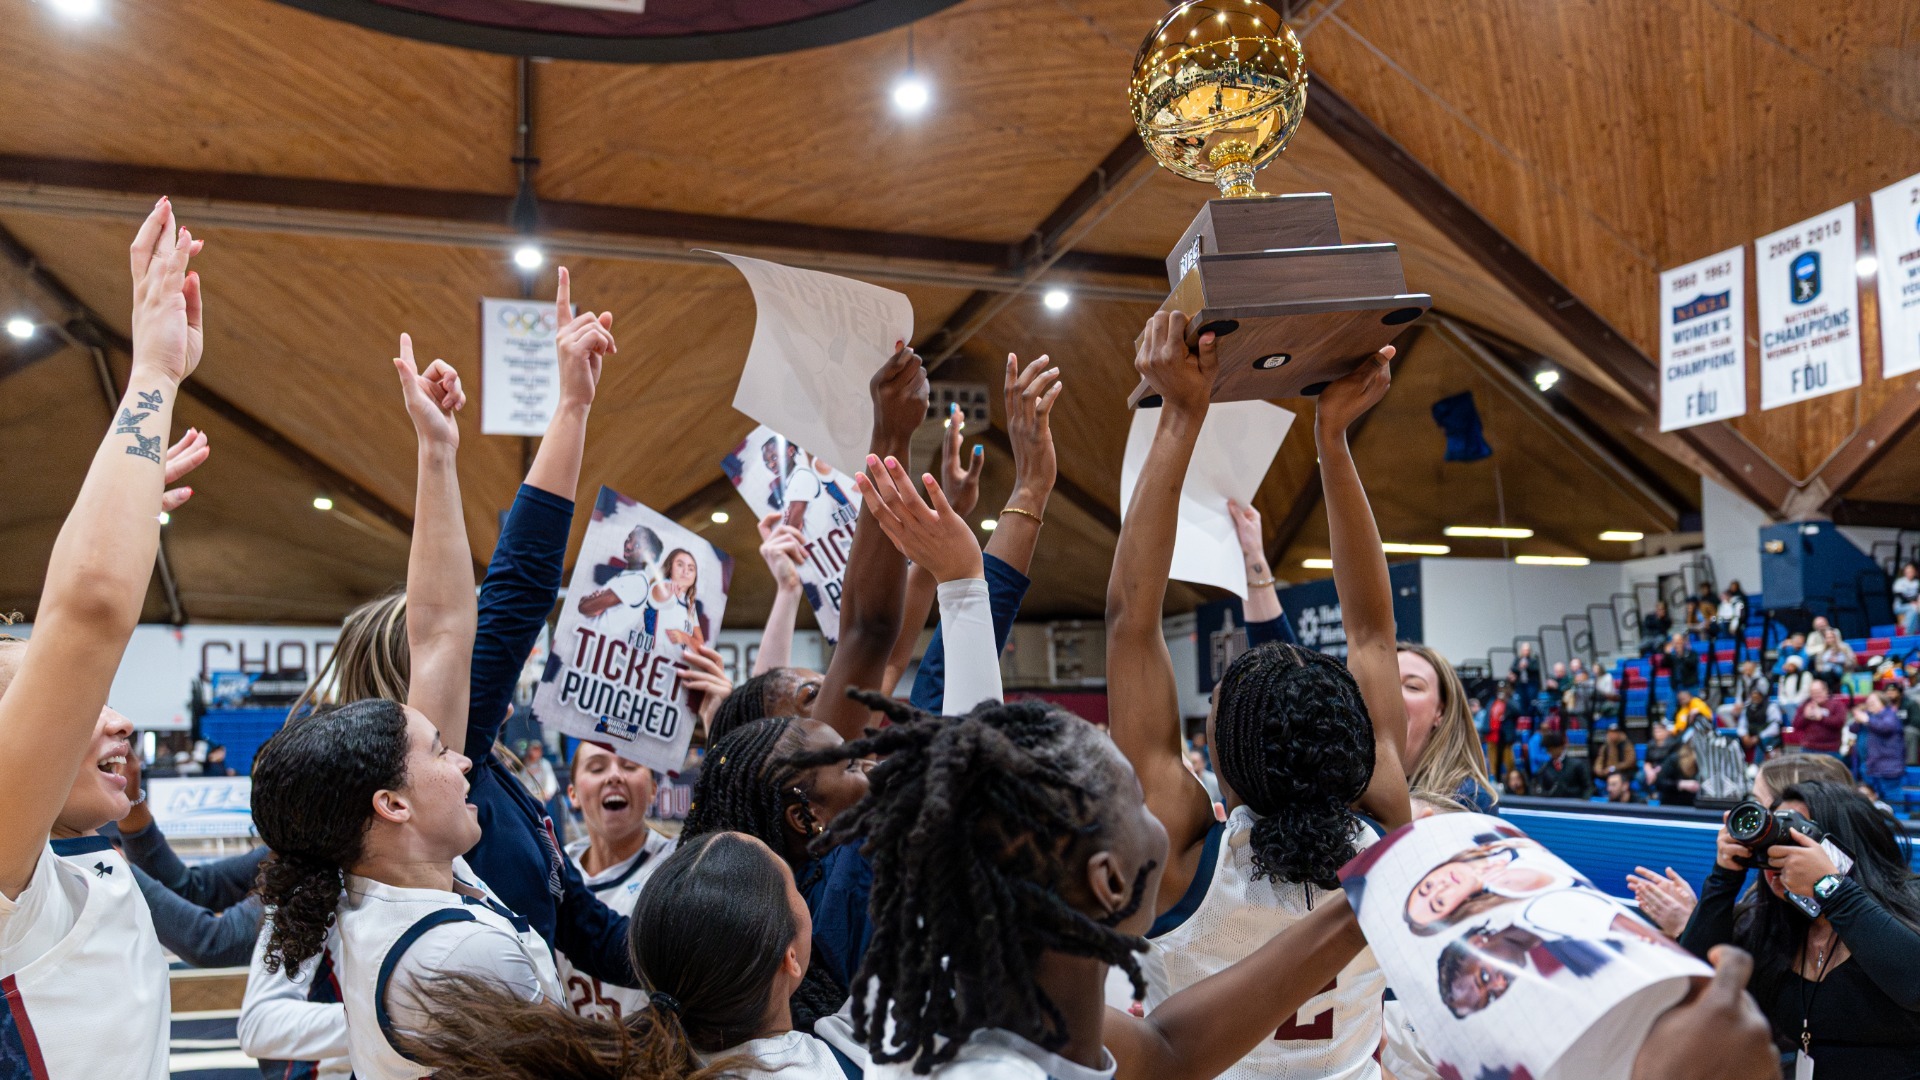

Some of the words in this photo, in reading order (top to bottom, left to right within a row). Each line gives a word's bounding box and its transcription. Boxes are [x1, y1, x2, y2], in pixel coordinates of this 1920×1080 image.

[1808, 220, 1841, 246] 2010
[1673, 316, 1732, 344] WOMEN'S
[1764, 308, 1850, 348] CHAMPIONS
[1667, 351, 1736, 381] CHAMPIONS
[1791, 359, 1828, 394] FDU
[1686, 388, 1718, 417] FDU
[831, 503, 857, 527] FDU
[805, 519, 857, 578] TIC
[575, 627, 690, 702] TICKET
[561, 671, 680, 739] PUNCHED
